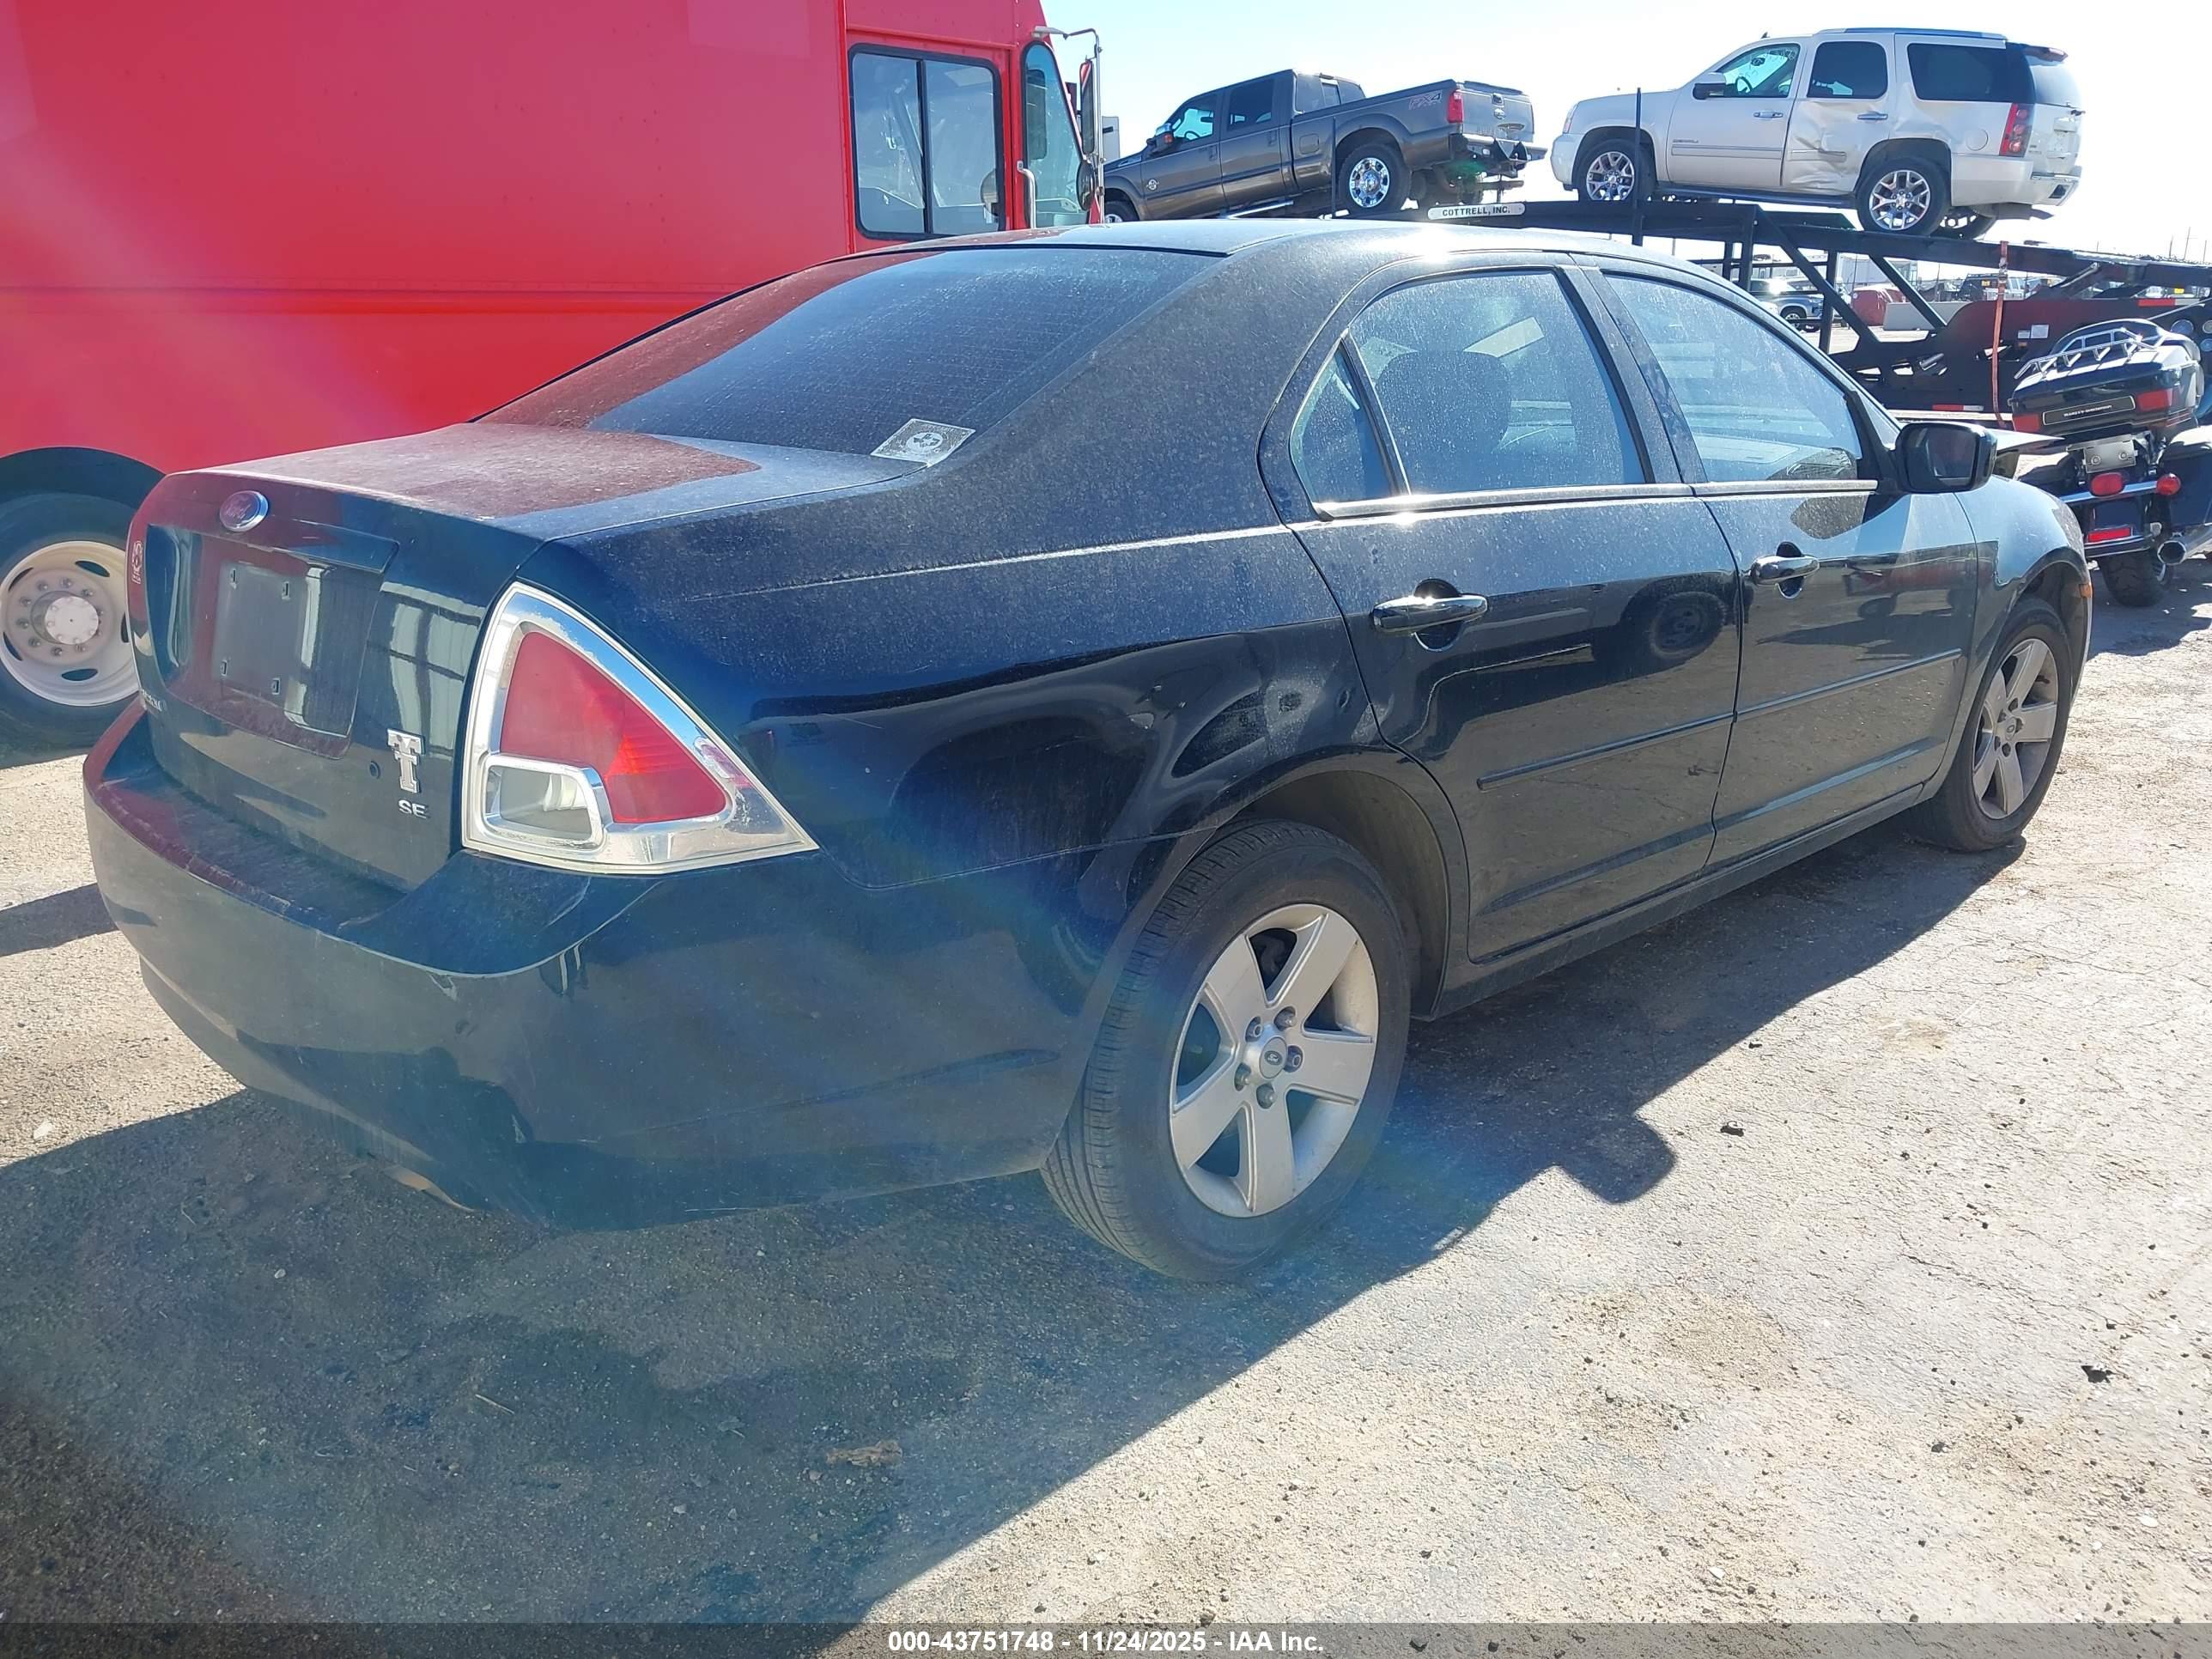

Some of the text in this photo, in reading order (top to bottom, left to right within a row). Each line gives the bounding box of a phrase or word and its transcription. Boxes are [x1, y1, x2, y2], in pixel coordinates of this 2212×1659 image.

[1443, 205, 1510, 216] COTTRELL, INC.
[398, 799, 428, 819] SE
